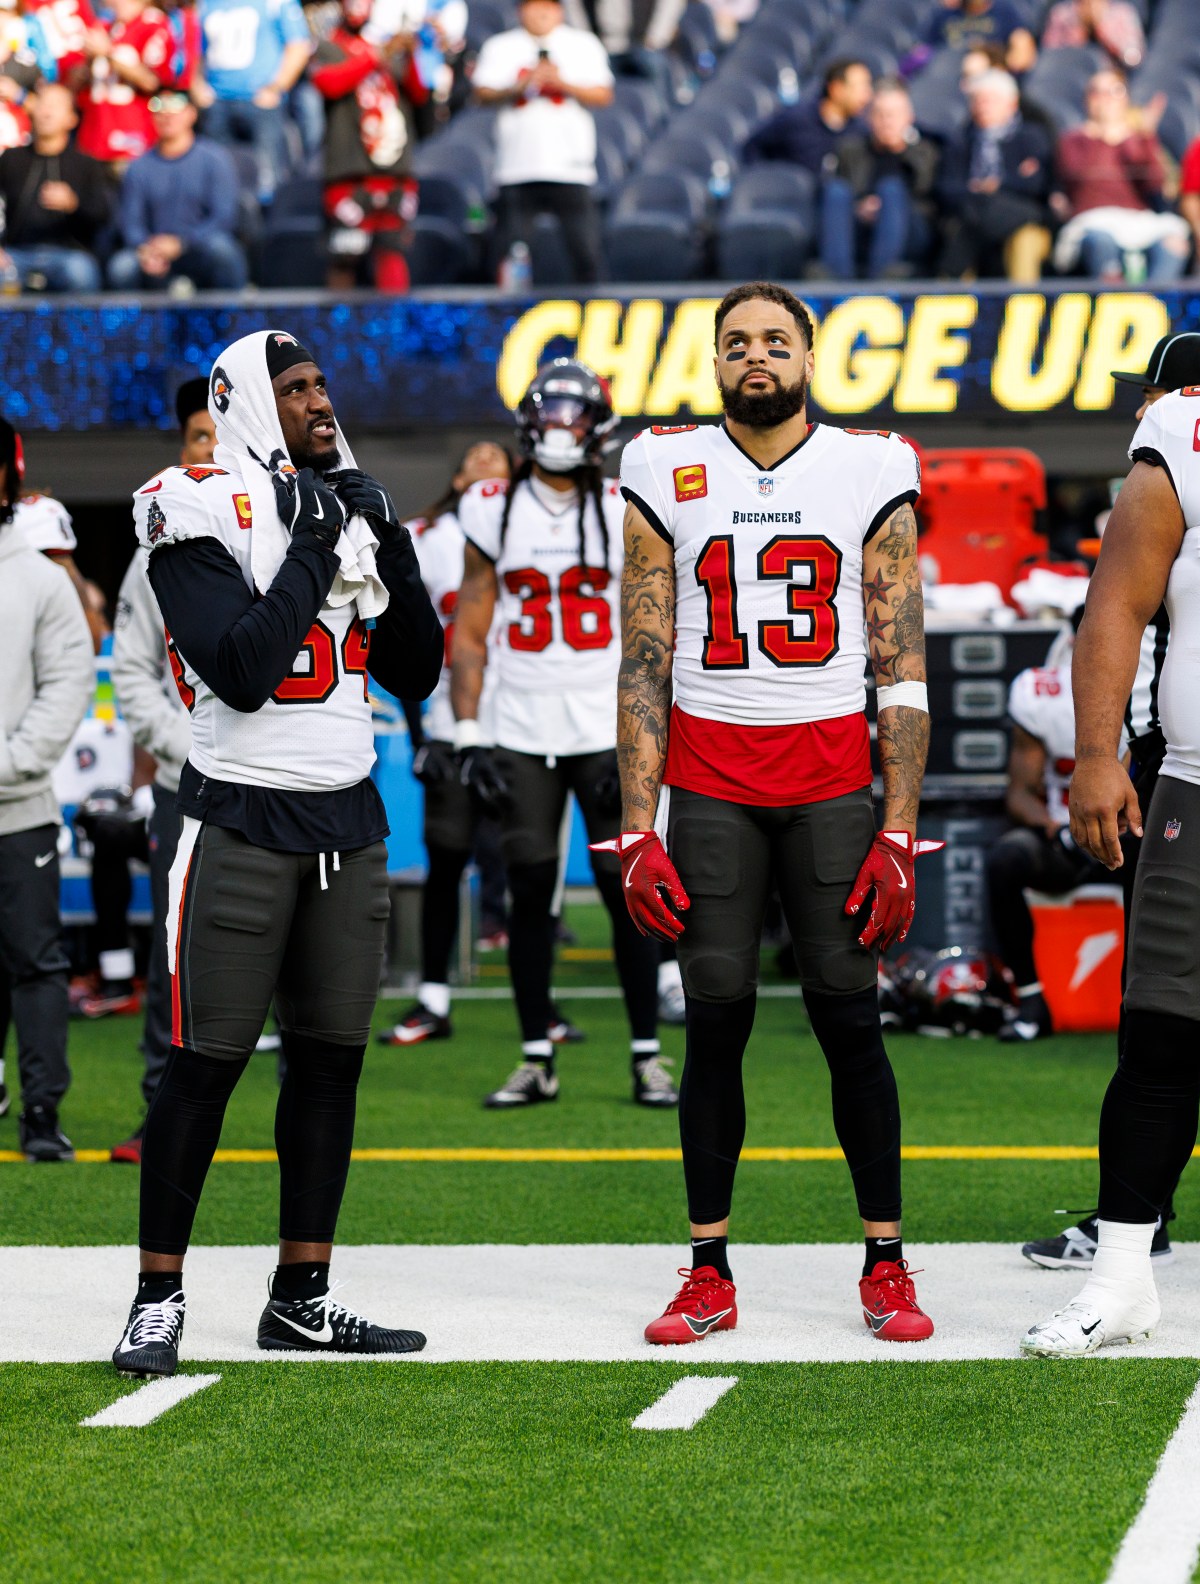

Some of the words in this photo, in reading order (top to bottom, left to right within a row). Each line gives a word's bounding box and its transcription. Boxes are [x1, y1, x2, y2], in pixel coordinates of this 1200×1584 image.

[497, 294, 978, 416] CHAGE
[990, 292, 1171, 412] UP
[504, 565, 613, 653] 36
[694, 534, 843, 670] 13
